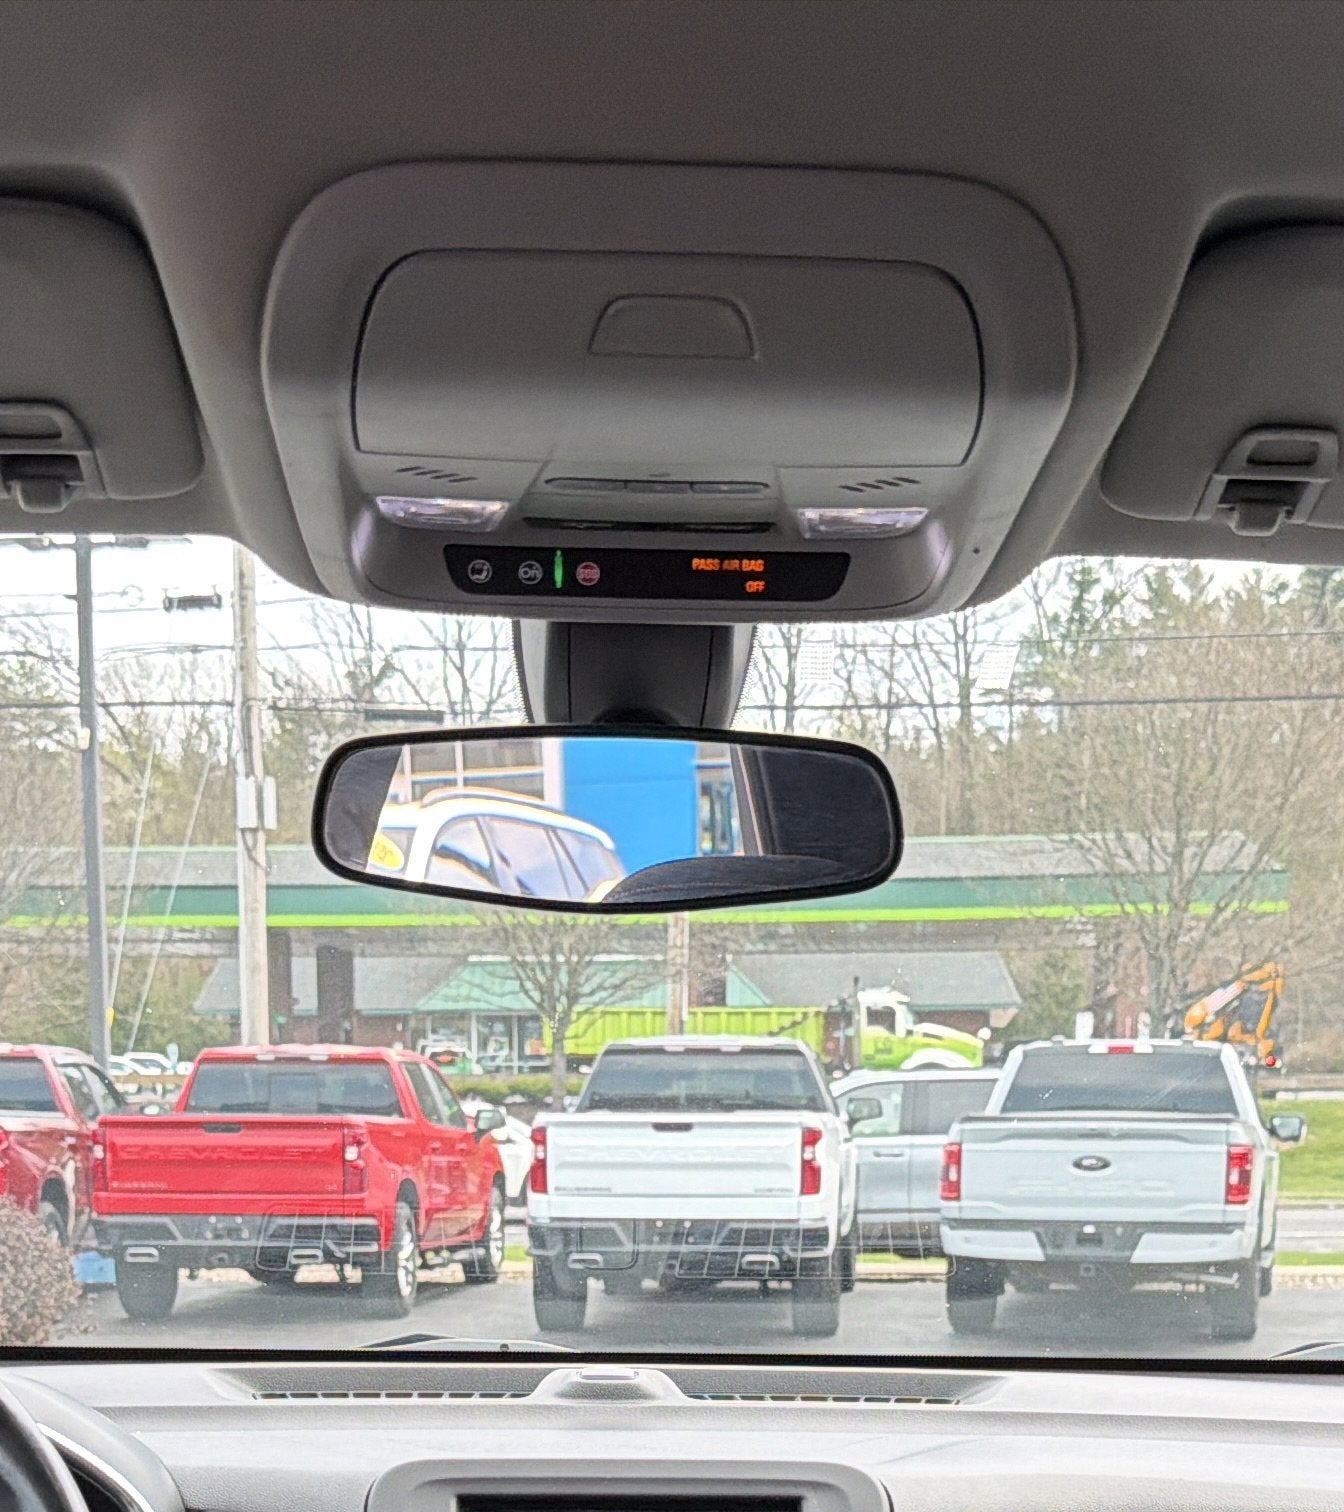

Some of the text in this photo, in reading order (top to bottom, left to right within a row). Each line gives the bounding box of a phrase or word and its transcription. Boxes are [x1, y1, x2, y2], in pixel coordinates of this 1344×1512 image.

[692, 559, 765, 572] PASS AIR BAG
[745, 581, 765, 593] OFF
